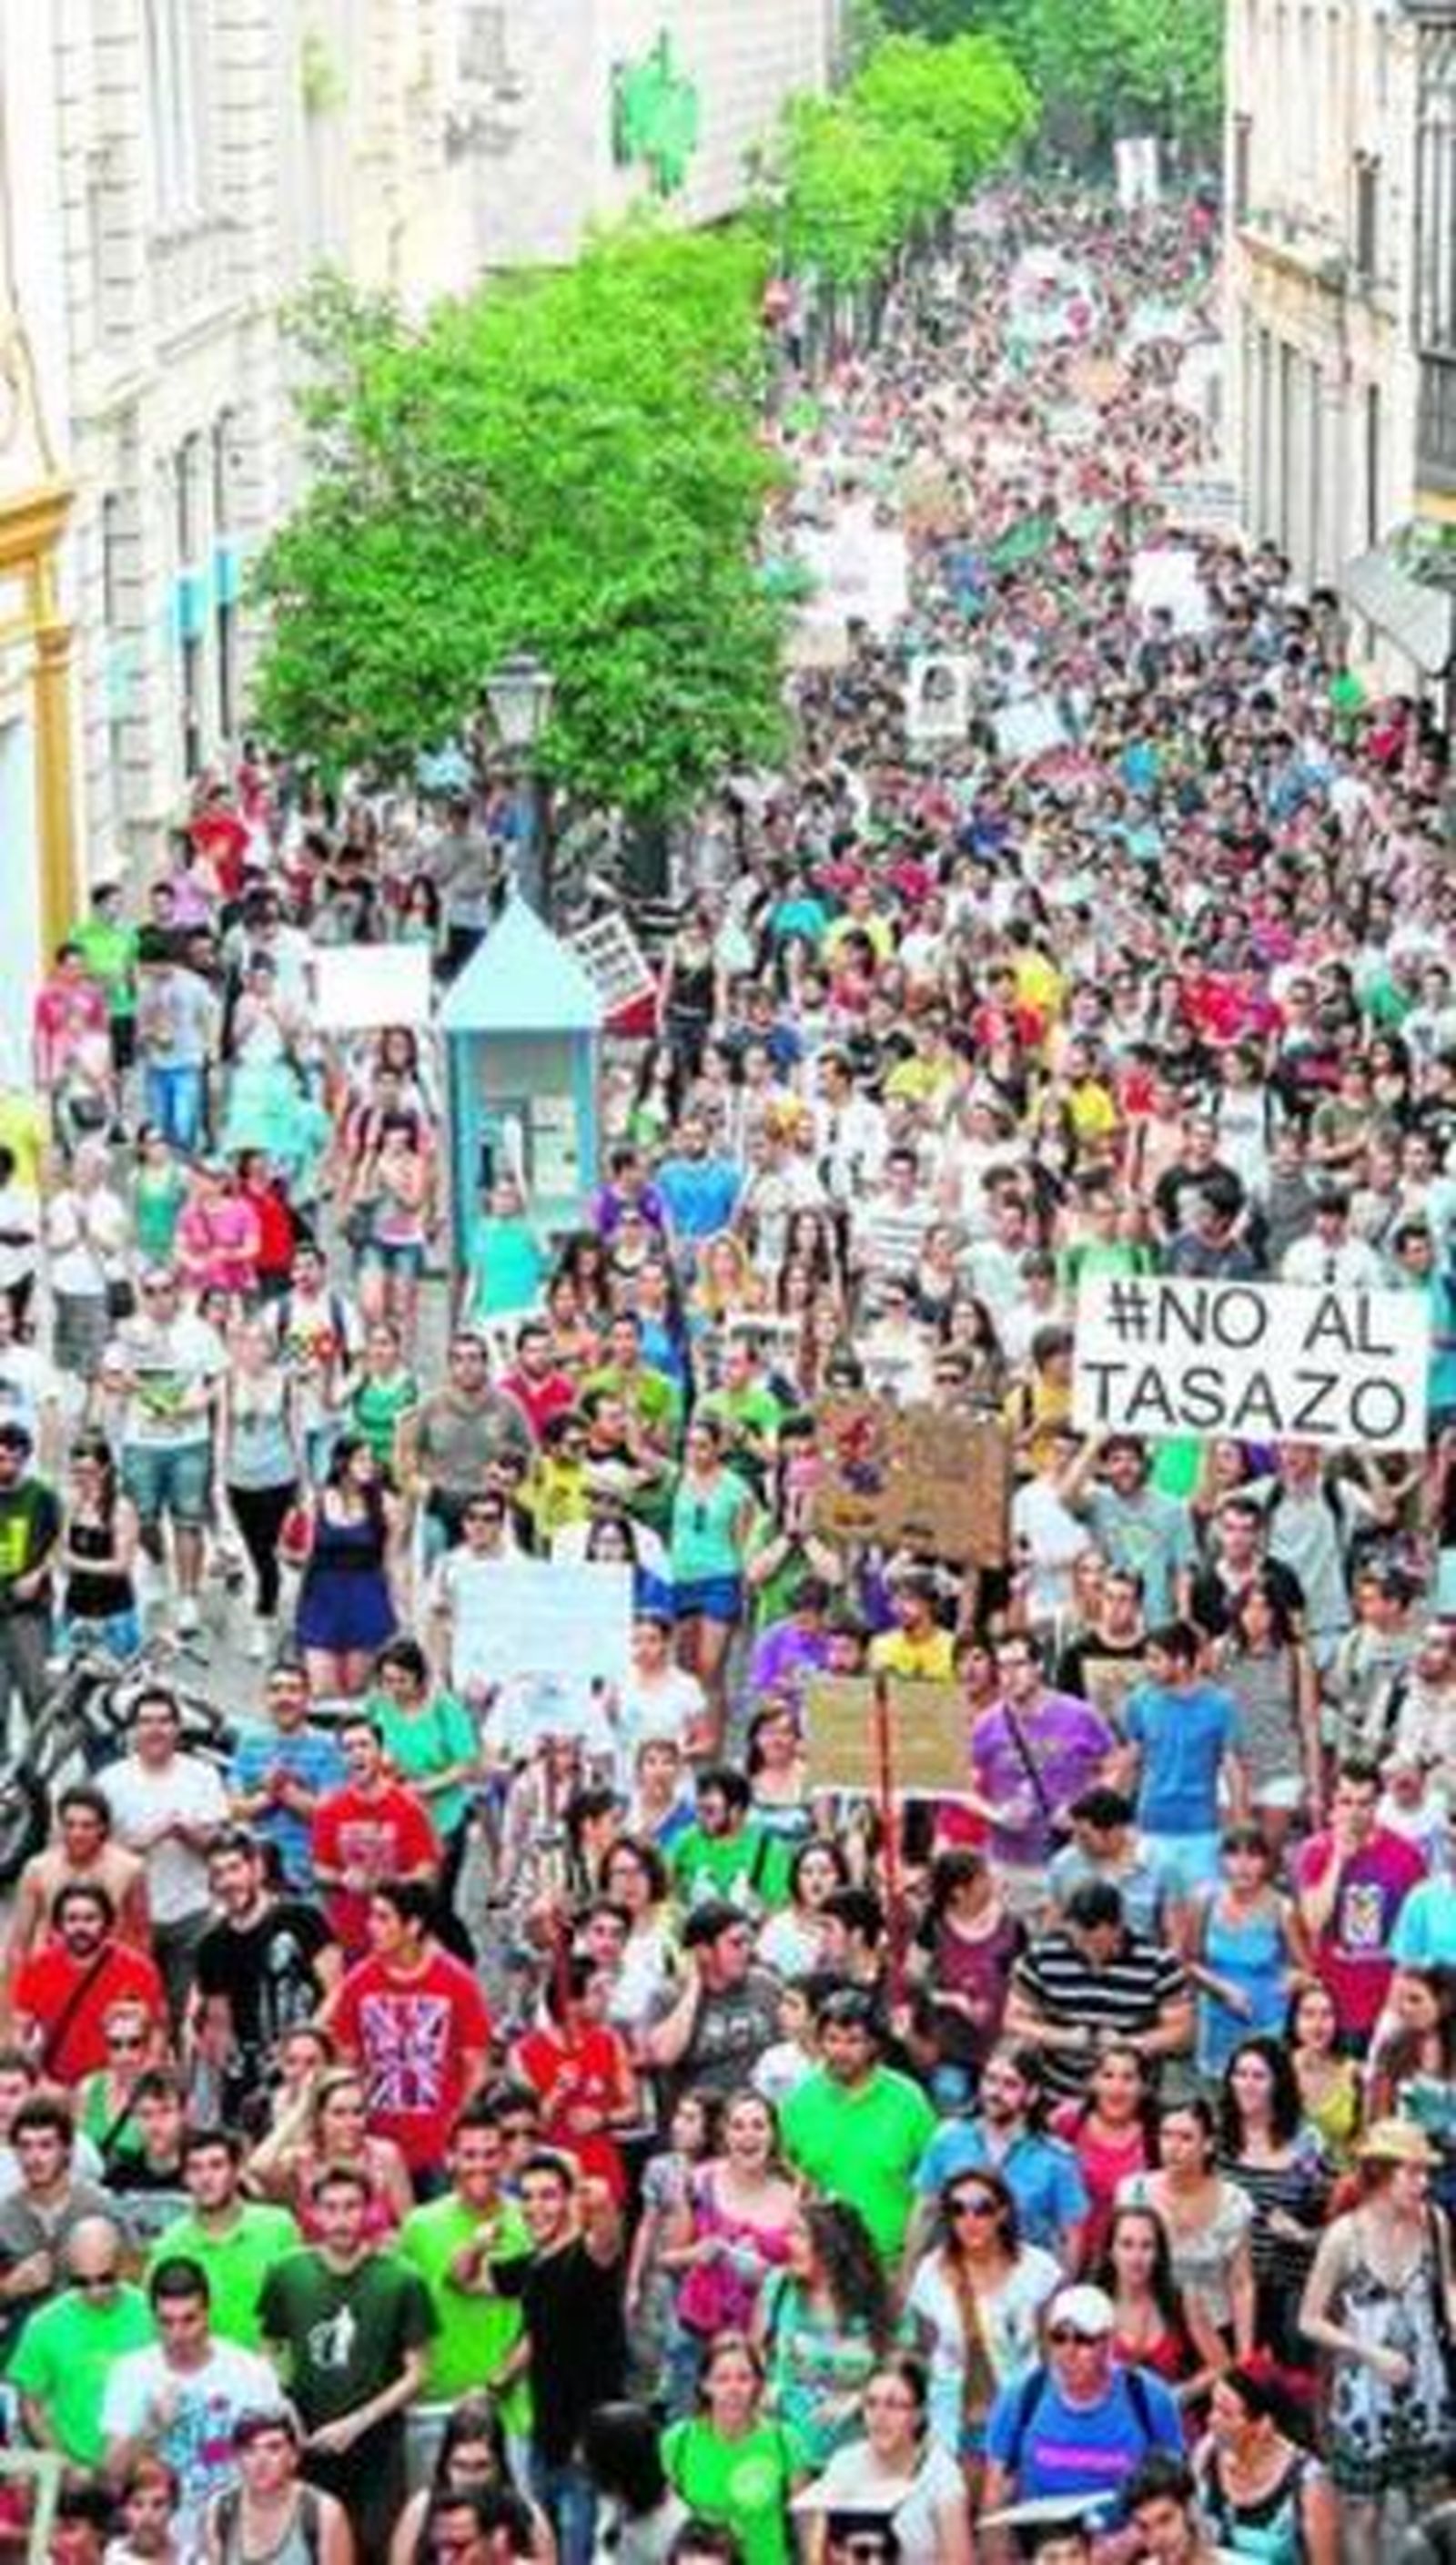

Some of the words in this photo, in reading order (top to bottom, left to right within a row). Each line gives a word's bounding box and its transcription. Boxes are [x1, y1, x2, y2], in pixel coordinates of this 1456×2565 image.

[1107, 1281, 1268, 1349] #NO
[1302, 1293, 1396, 1356] AL
[1083, 1363, 1405, 1439] TASAZO
